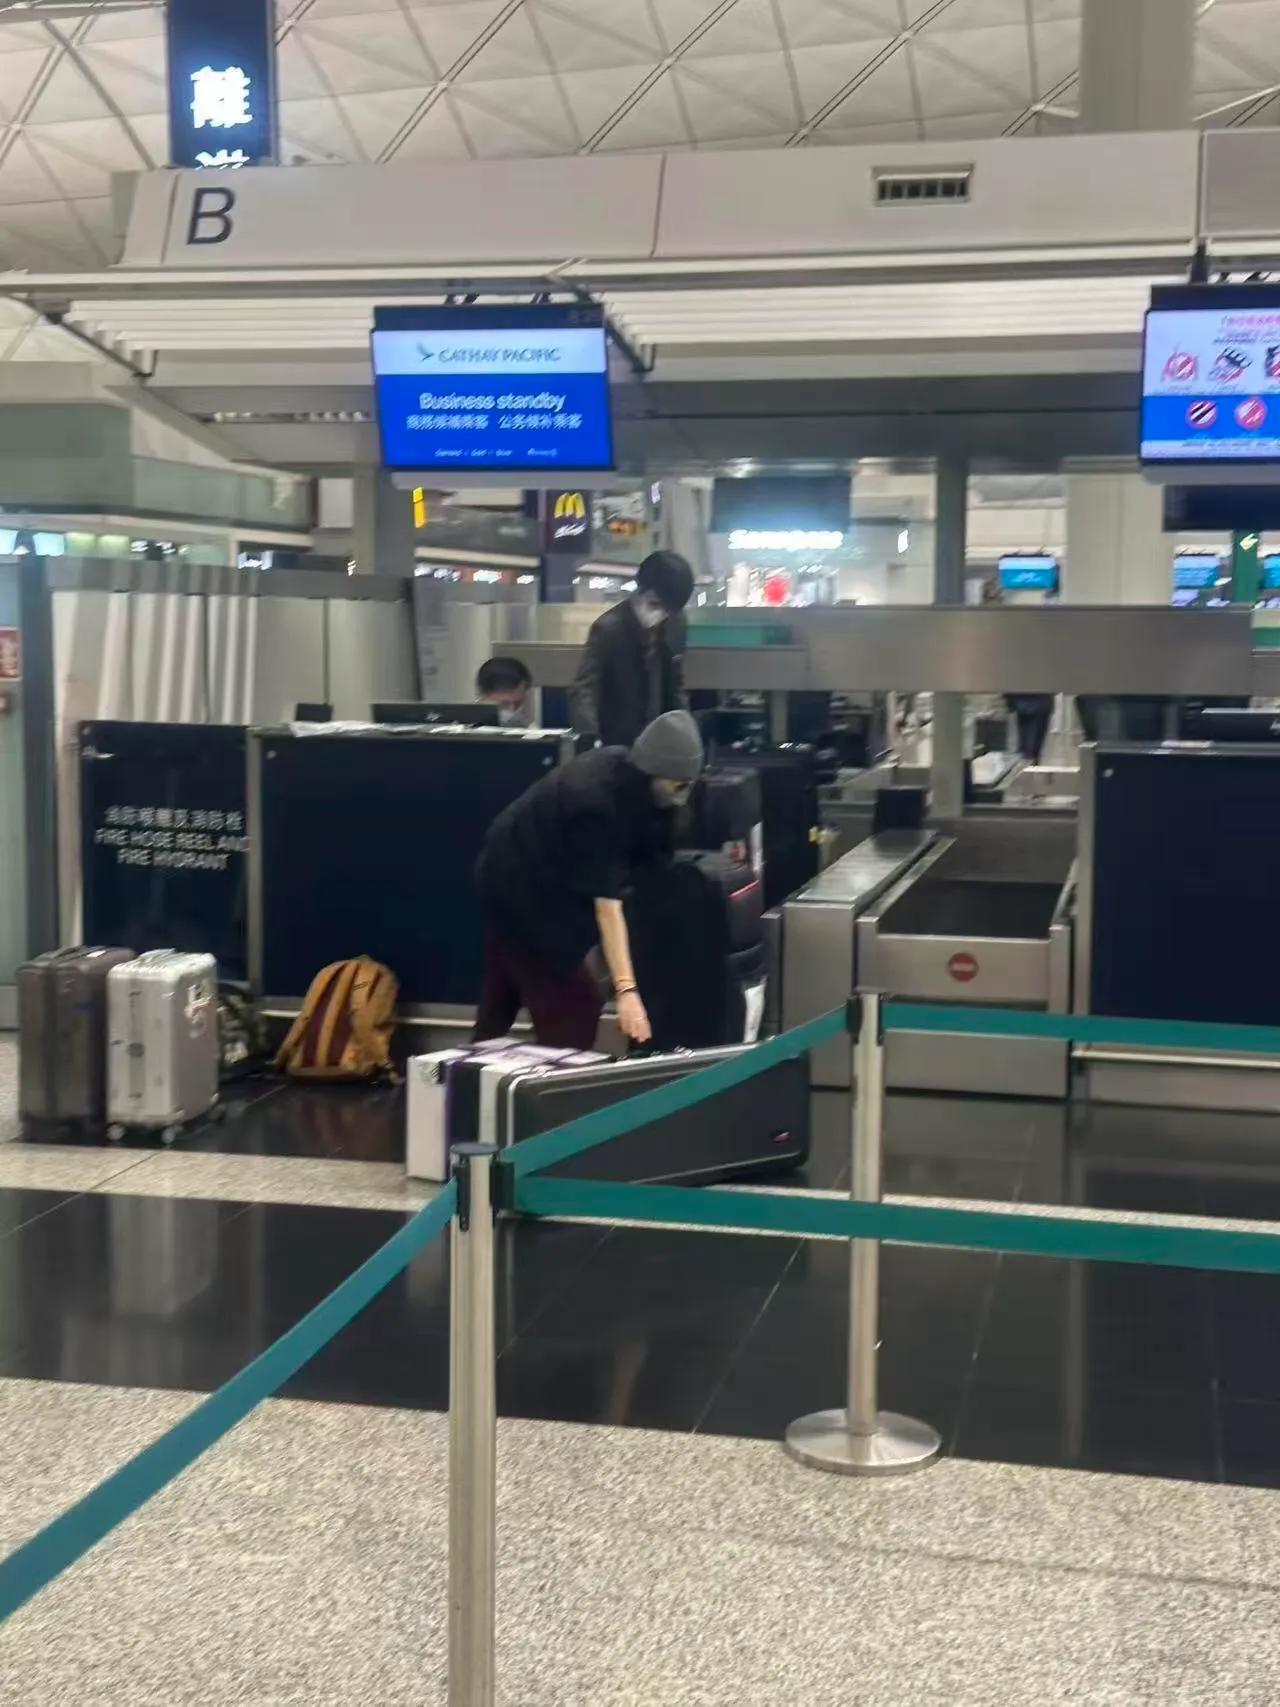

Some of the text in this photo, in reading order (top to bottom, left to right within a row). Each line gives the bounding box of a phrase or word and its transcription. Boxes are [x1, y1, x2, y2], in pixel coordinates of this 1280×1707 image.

[186, 187, 236, 245] B
[438, 346, 562, 363] CATHAY PACIFIC
[419, 391, 567, 412] Business standby
[95, 828, 129, 847] FIRE
[130, 831, 174, 848] HOSE
[175, 833, 215, 850] REEL
[117, 849, 152, 866] FIRE
